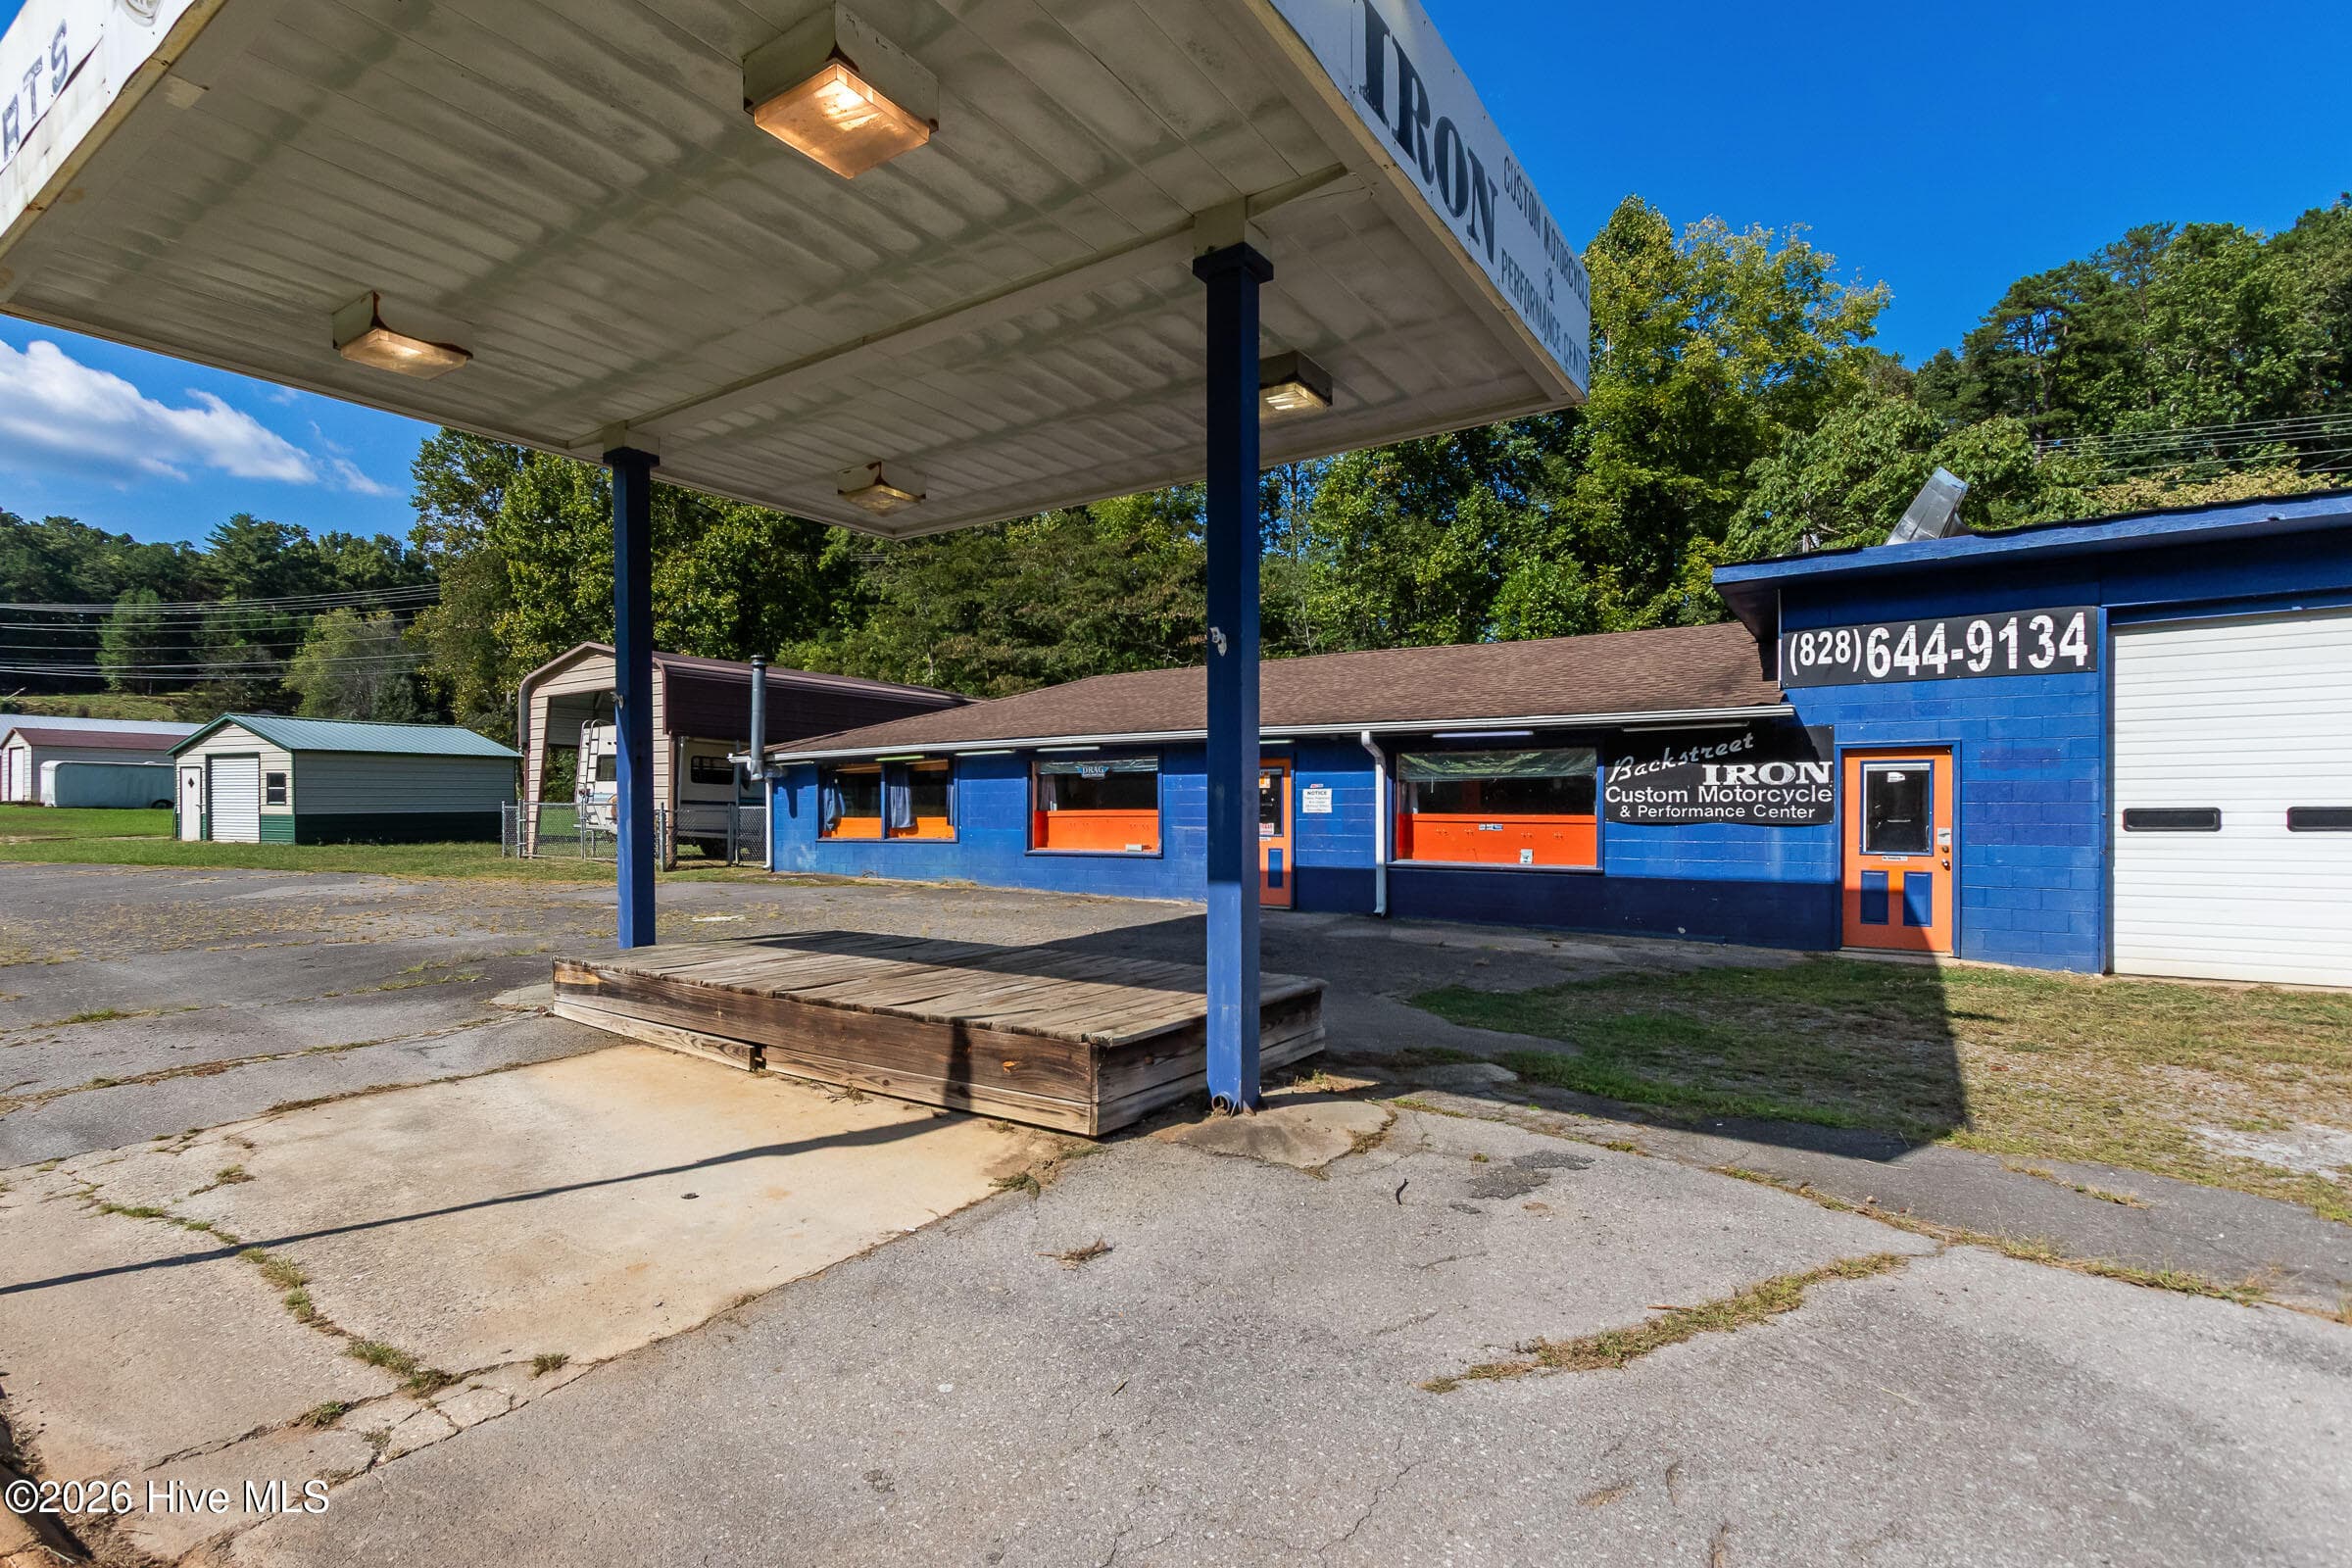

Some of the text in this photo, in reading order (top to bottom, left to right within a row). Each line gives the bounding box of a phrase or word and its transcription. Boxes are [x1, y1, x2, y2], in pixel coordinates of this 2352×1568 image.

[1358, 0, 1498, 266] IRON
[1503, 155, 1541, 239] CUSTOM
[1544, 216, 1589, 312] MOTORCYCLE
[1545, 267, 1555, 306] &
[1501, 247, 1561, 356] PERFORMANCE
[1607, 732, 1754, 784] Backstreet
[1701, 760, 1834, 786] IRON
[1605, 785, 1833, 806] Custom Motorcycle
[1619, 804, 1815, 818] & Performance Center
